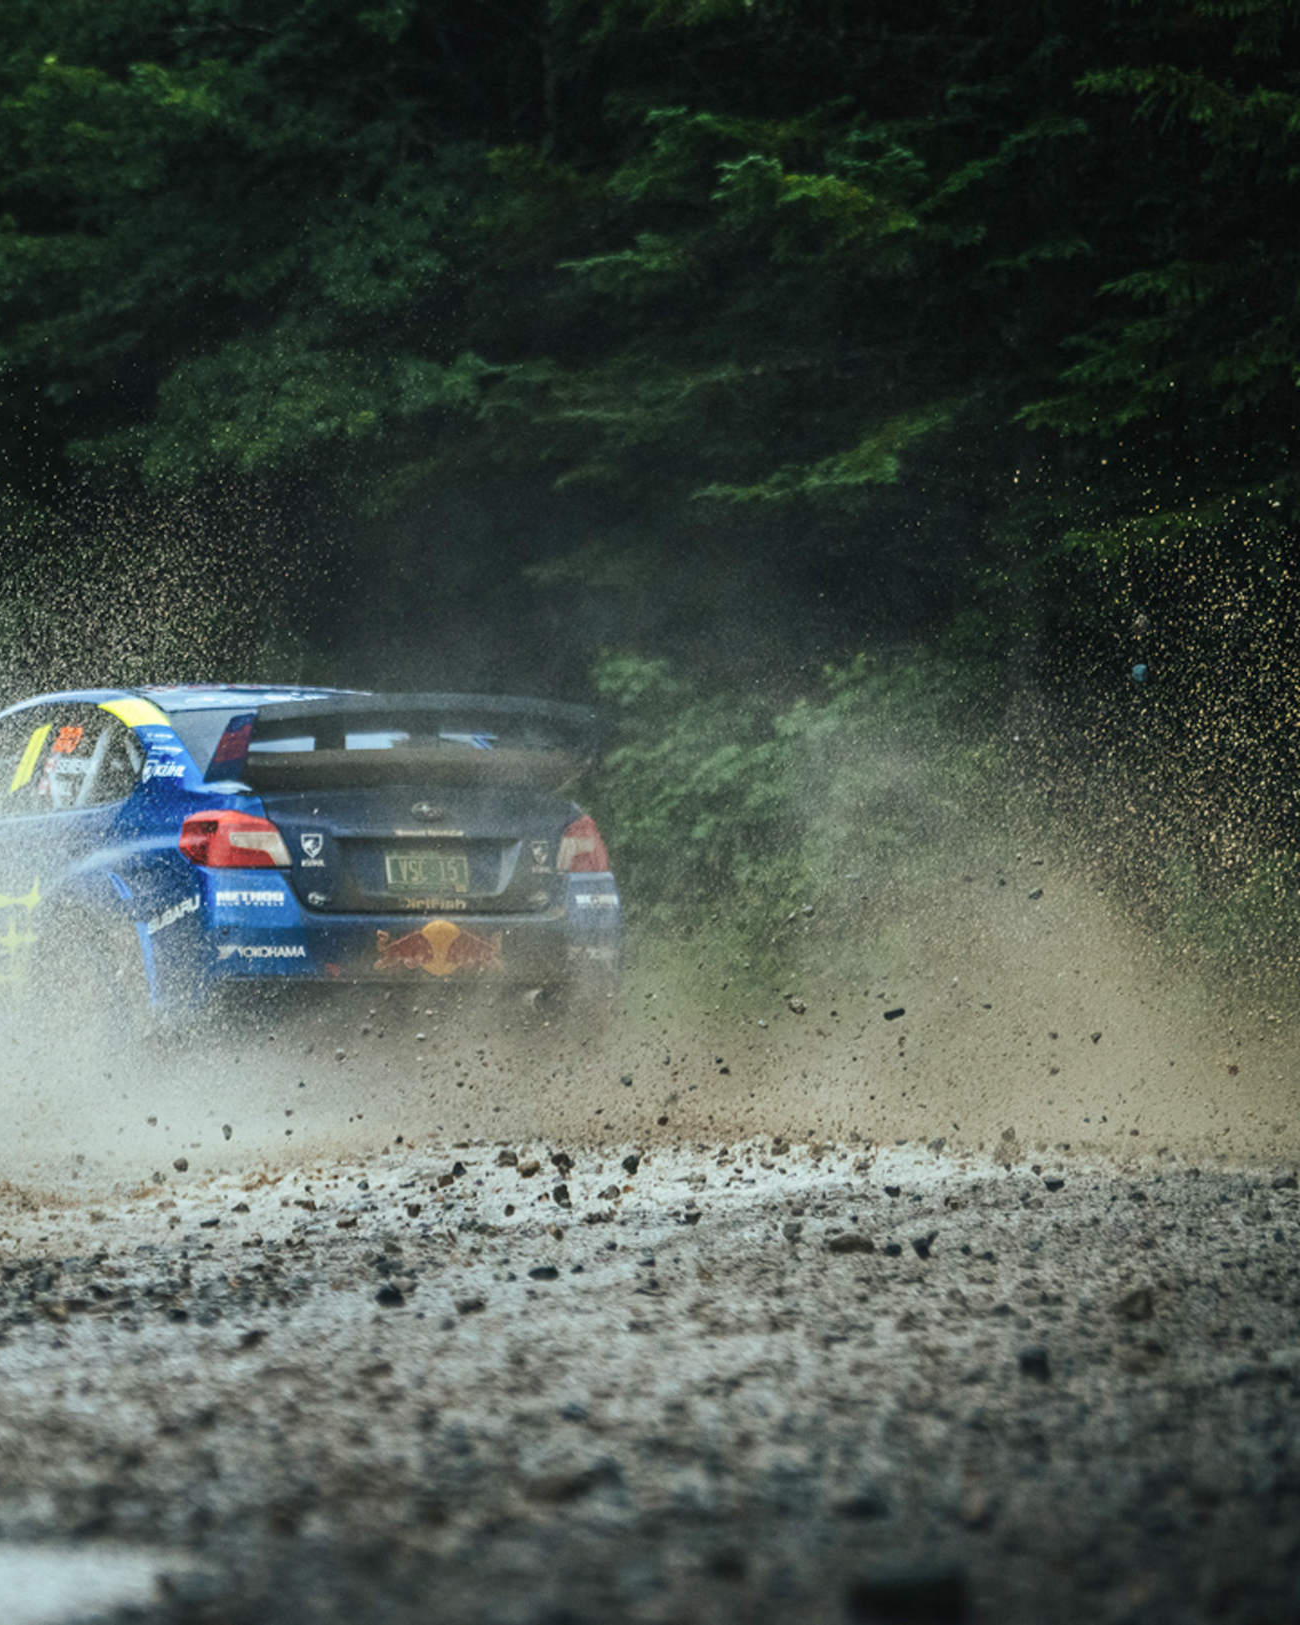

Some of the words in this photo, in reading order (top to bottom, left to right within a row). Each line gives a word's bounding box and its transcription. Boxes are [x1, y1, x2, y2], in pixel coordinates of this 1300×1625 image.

[215, 891, 285, 902] METHOD
[147, 894, 200, 935] SUBARU
[237, 945, 306, 958] YOKOHAMA
